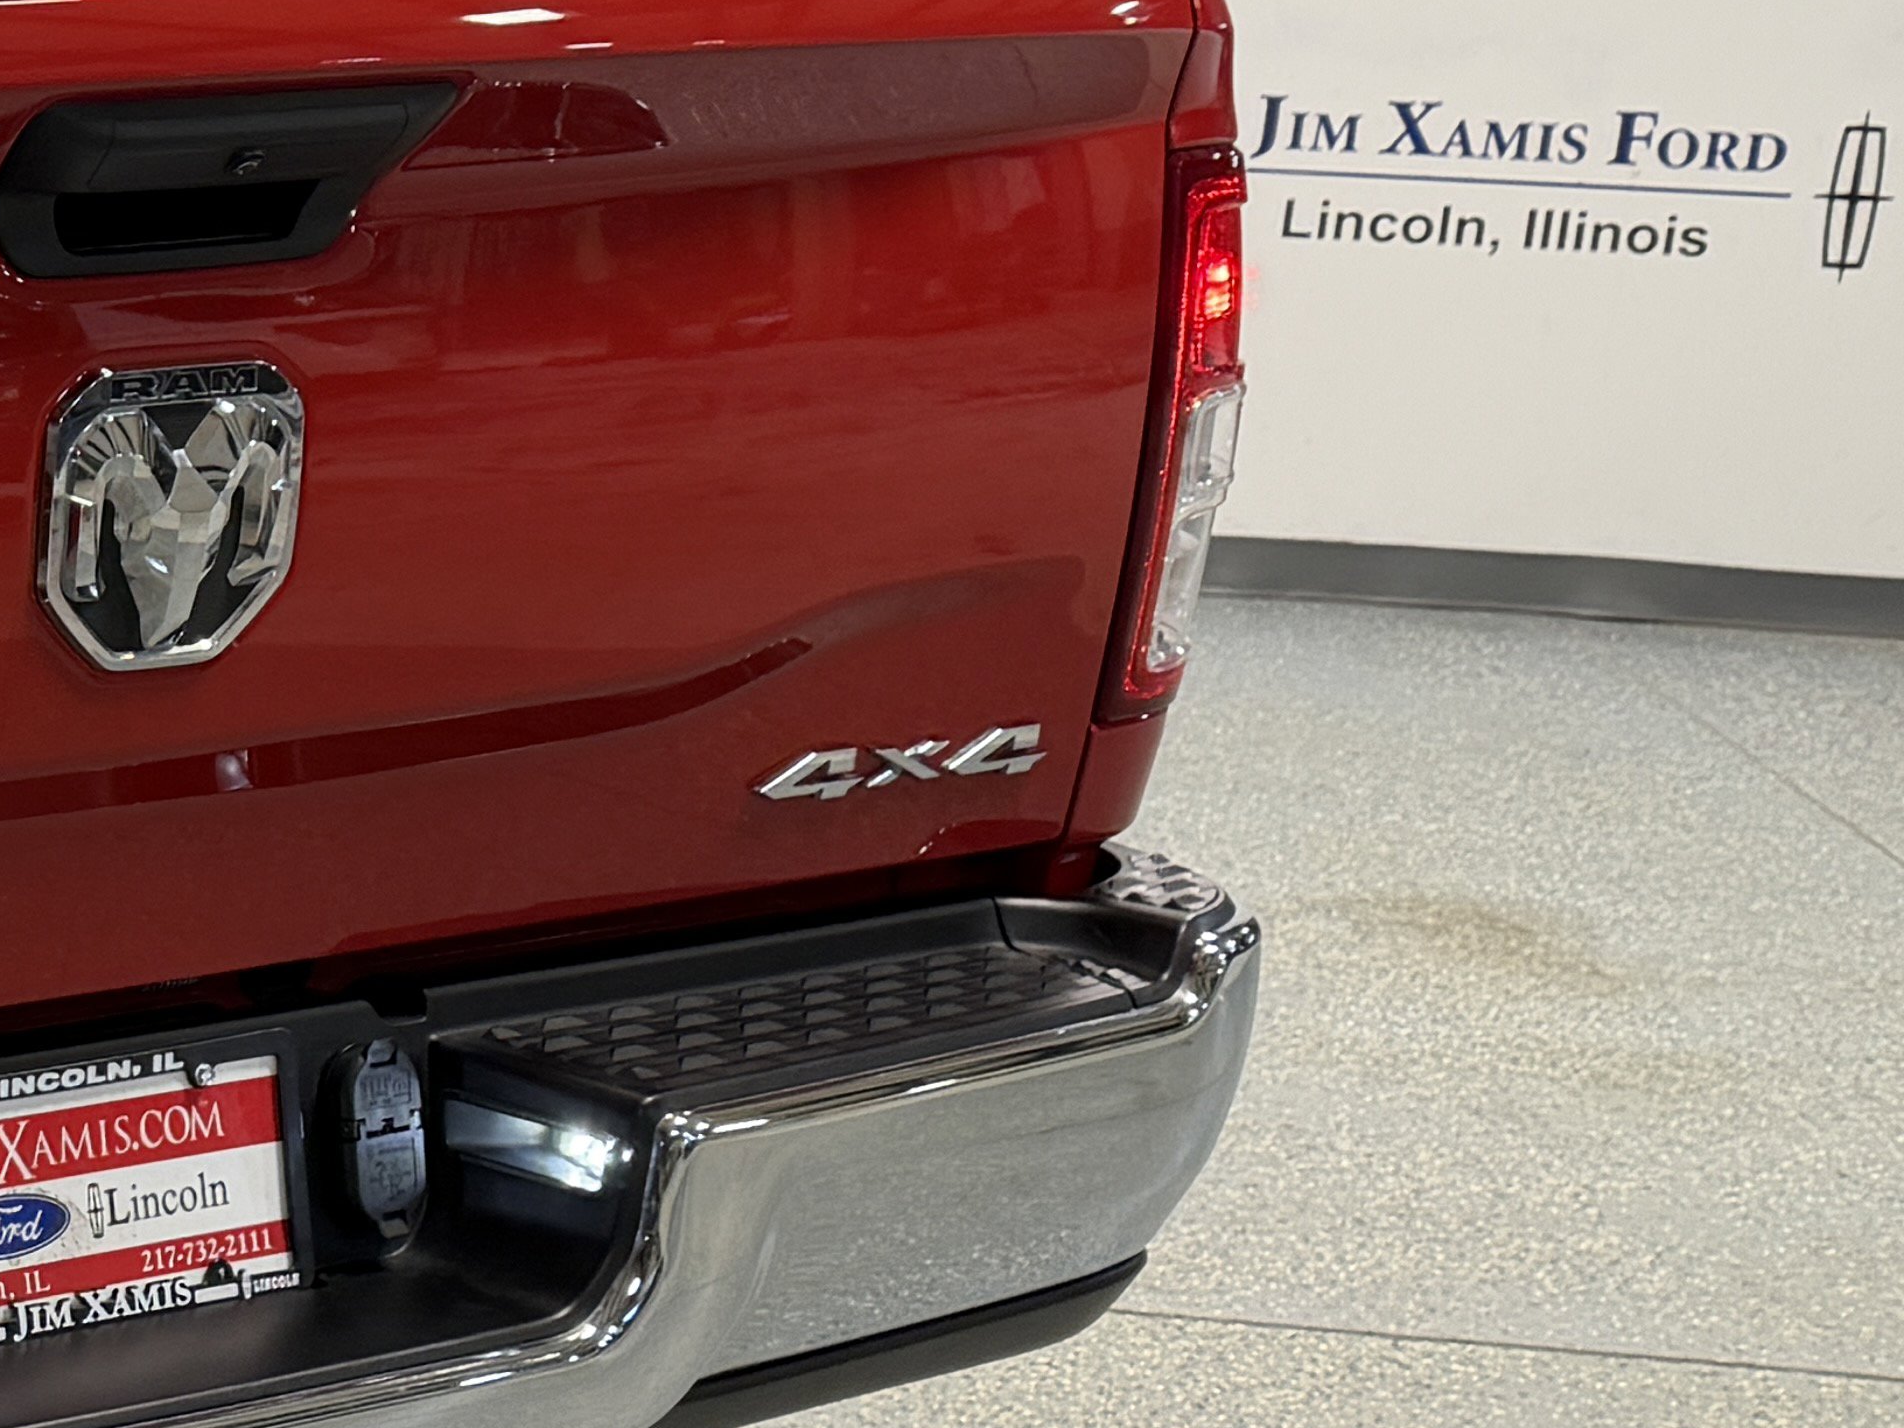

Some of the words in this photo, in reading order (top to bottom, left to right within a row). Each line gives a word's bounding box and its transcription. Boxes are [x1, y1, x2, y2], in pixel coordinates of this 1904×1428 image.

[1250, 93, 1361, 159] JIM
[1379, 100, 1589, 165] XAMIS
[1608, 110, 1789, 172] FORD
[1281, 199, 1500, 256] Lincoln,
[1523, 209, 1710, 257] Illinois
[110, 365, 259, 401] RAM
[152, 1051, 185, 1072] IL
[106, 1172, 230, 1227] Lincoln
[140, 1227, 273, 1273] 217-732-2111
[23, 1270, 51, 1295] IL
[12, 1303, 76, 1342] JIM
[81, 1277, 192, 1326] XAMIS
